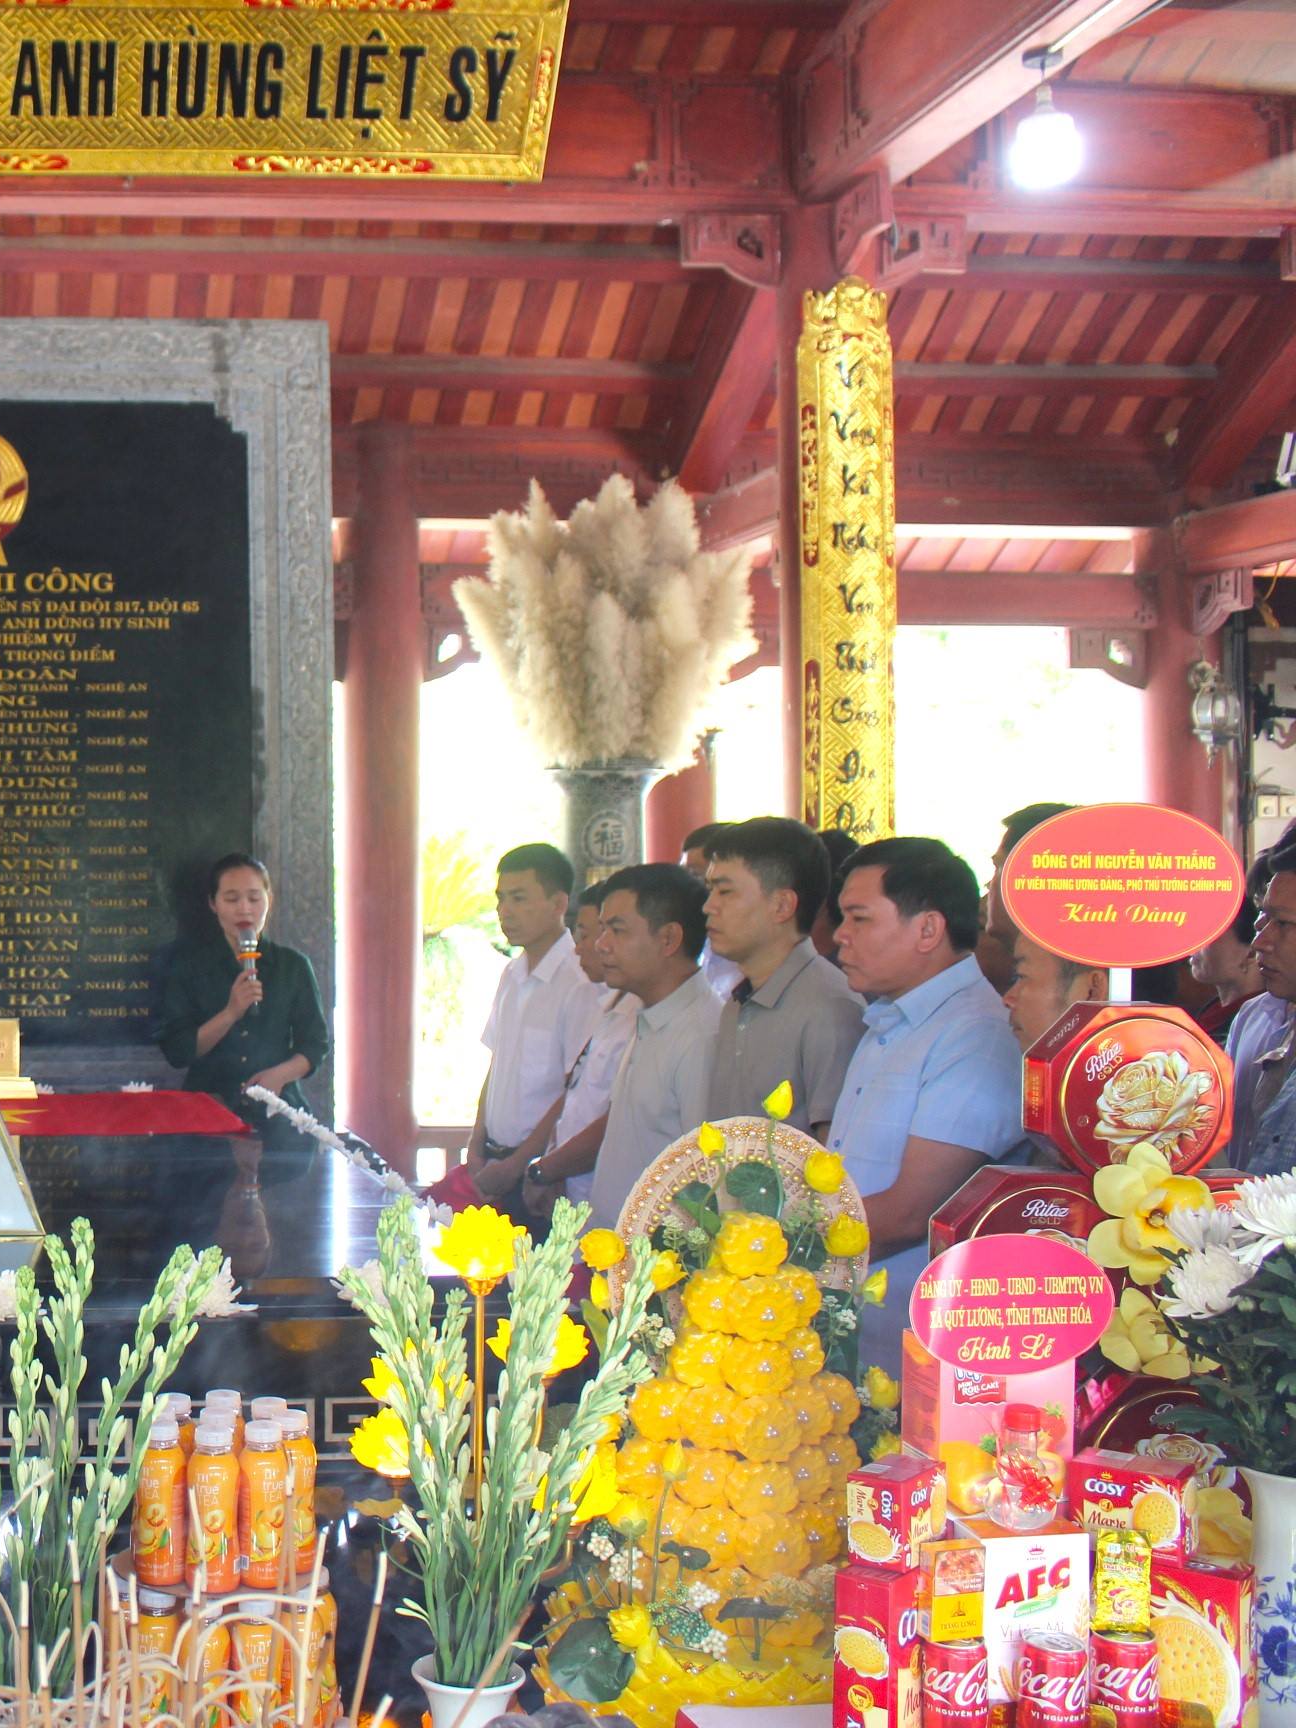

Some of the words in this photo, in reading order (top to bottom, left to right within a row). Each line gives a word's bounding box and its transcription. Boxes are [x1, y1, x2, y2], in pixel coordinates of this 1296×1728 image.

[11, 38, 117, 118] ANH
[142, 28, 282, 118] HÙNG
[304, 32, 422, 140] LIỆT
[443, 38, 515, 125] SỸ
[24, 567, 115, 593] CÔNG
[4, 617, 39, 630] ANH
[100, 617, 124, 630] HY
[128, 617, 170, 630] SINH
[53, 633, 76, 647] VỤ
[4, 650, 65, 665] TRỌNG
[1032, 850, 1067, 869] ĐỒNG
[1071, 851, 1092, 869] CHÍ
[1096, 849, 1144, 870] NGUYỄN
[1148, 852, 1172, 870] VĂN
[1175, 849, 1216, 870] THẮNG
[1027, 876, 1046, 890] VIÊN
[1047, 879, 1074, 890] TRUNG
[1075, 878, 1099, 891] ƯƠNG
[1127, 876, 1143, 891] PHÓ
[1145, 876, 1160, 891] THỦ
[1161, 876, 1189, 891] TƯỚNG
[1190, 876, 1215, 891] CHÍNH
[1216, 876, 1232, 891] PHỦ
[1058, 902, 1118, 923] Kính
[1124, 903, 1187, 926] Dâng
[1085, 1042, 1122, 1082] Ritaz
[1097, 1056, 1123, 1081] GOLD
[1022, 1199, 1070, 1218] Ritaz
[1030, 1217, 1061, 1225] GOLD
[970, 1278, 999, 1296] HĐND
[1008, 1277, 1036, 1295] UBND
[1044, 1276, 1086, 1297] UBMTTQ
[1090, 1276, 1104, 1294] VN
[1006, 1302, 1030, 1325] TỈNH
[1033, 1307, 1067, 1324] THANH
[1070, 1303, 1092, 1323] HÓA
[958, 1336, 1011, 1361] Kính
[1020, 1334, 1055, 1359] Lễ
[911, 1487, 927, 1505] COSY
[1085, 1478, 1127, 1497] COSY
[881, 1490, 893, 1521] COSY
[1087, 1511, 1127, 1529] Marie
[995, 1557, 1070, 1610] AFC
[936, 1706, 972, 1717] NGUYÊN
[1108, 1703, 1146, 1714] NGUYÊN
